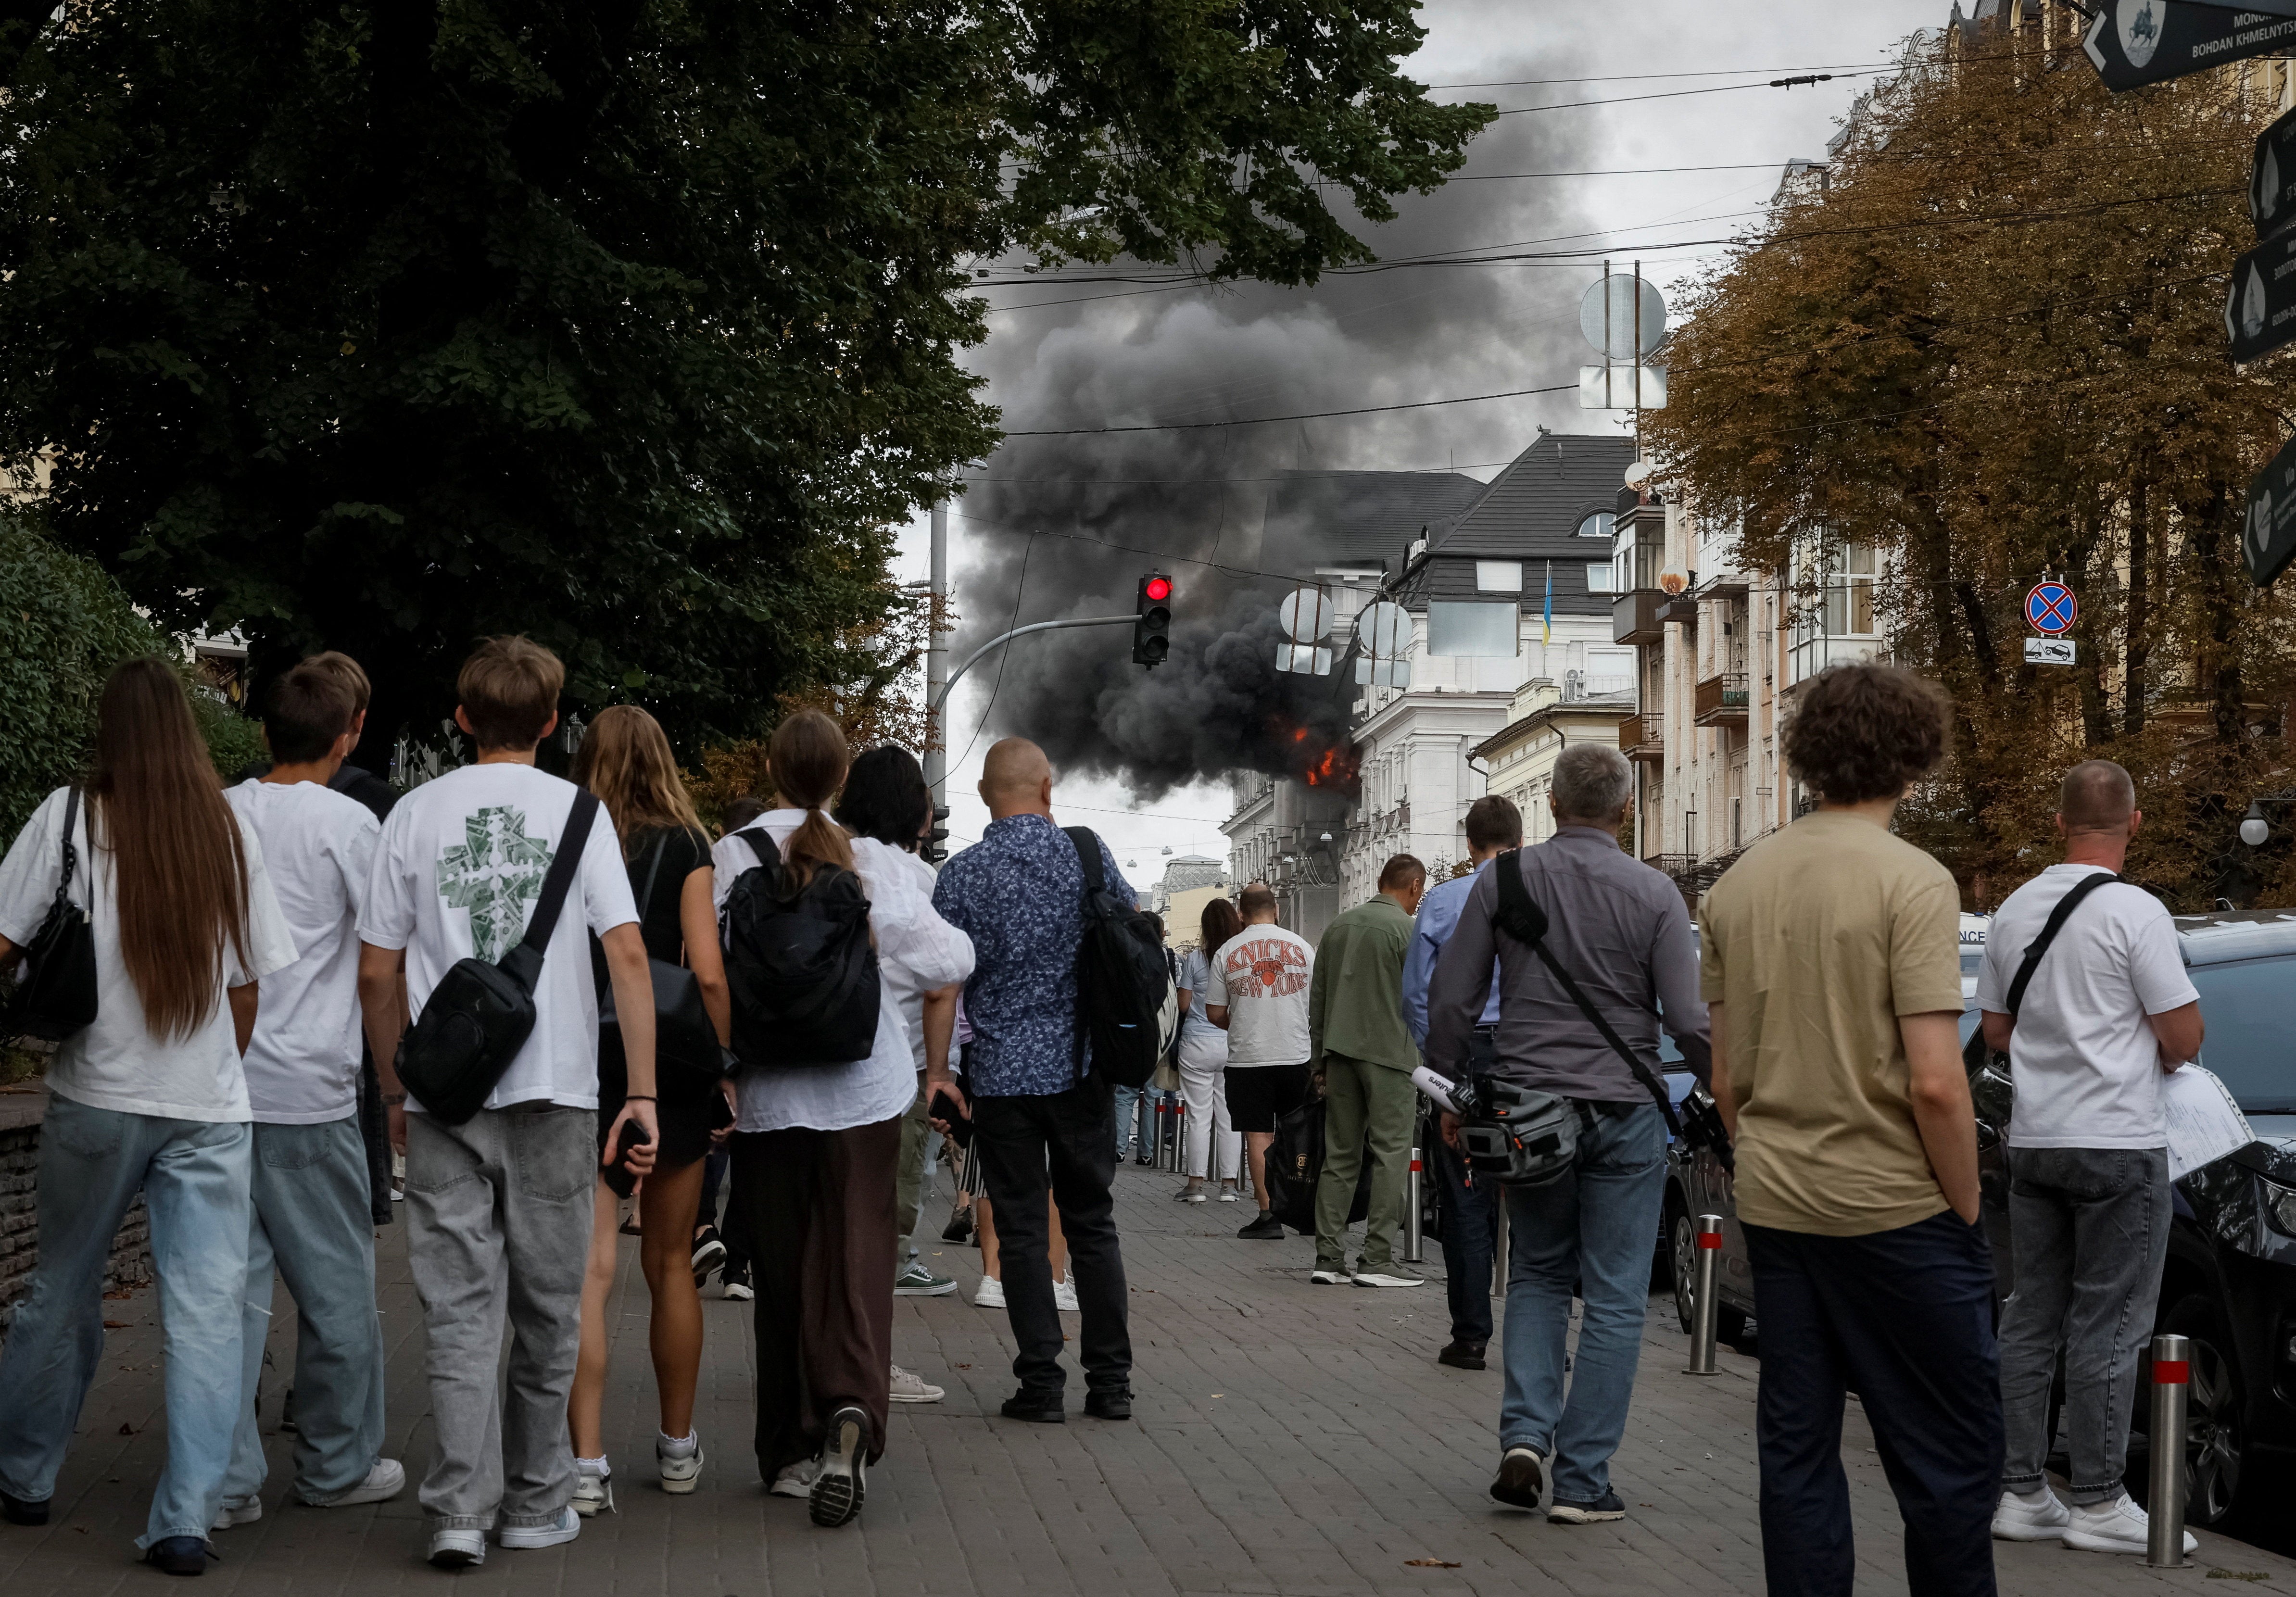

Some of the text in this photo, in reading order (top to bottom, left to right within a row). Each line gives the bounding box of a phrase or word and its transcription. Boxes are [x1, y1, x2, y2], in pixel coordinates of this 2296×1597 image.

[2192, 36, 2233, 58] BOHDAN
[1226, 938, 1307, 975] KNICKS
[1228, 972, 1308, 998] NEW YORK
